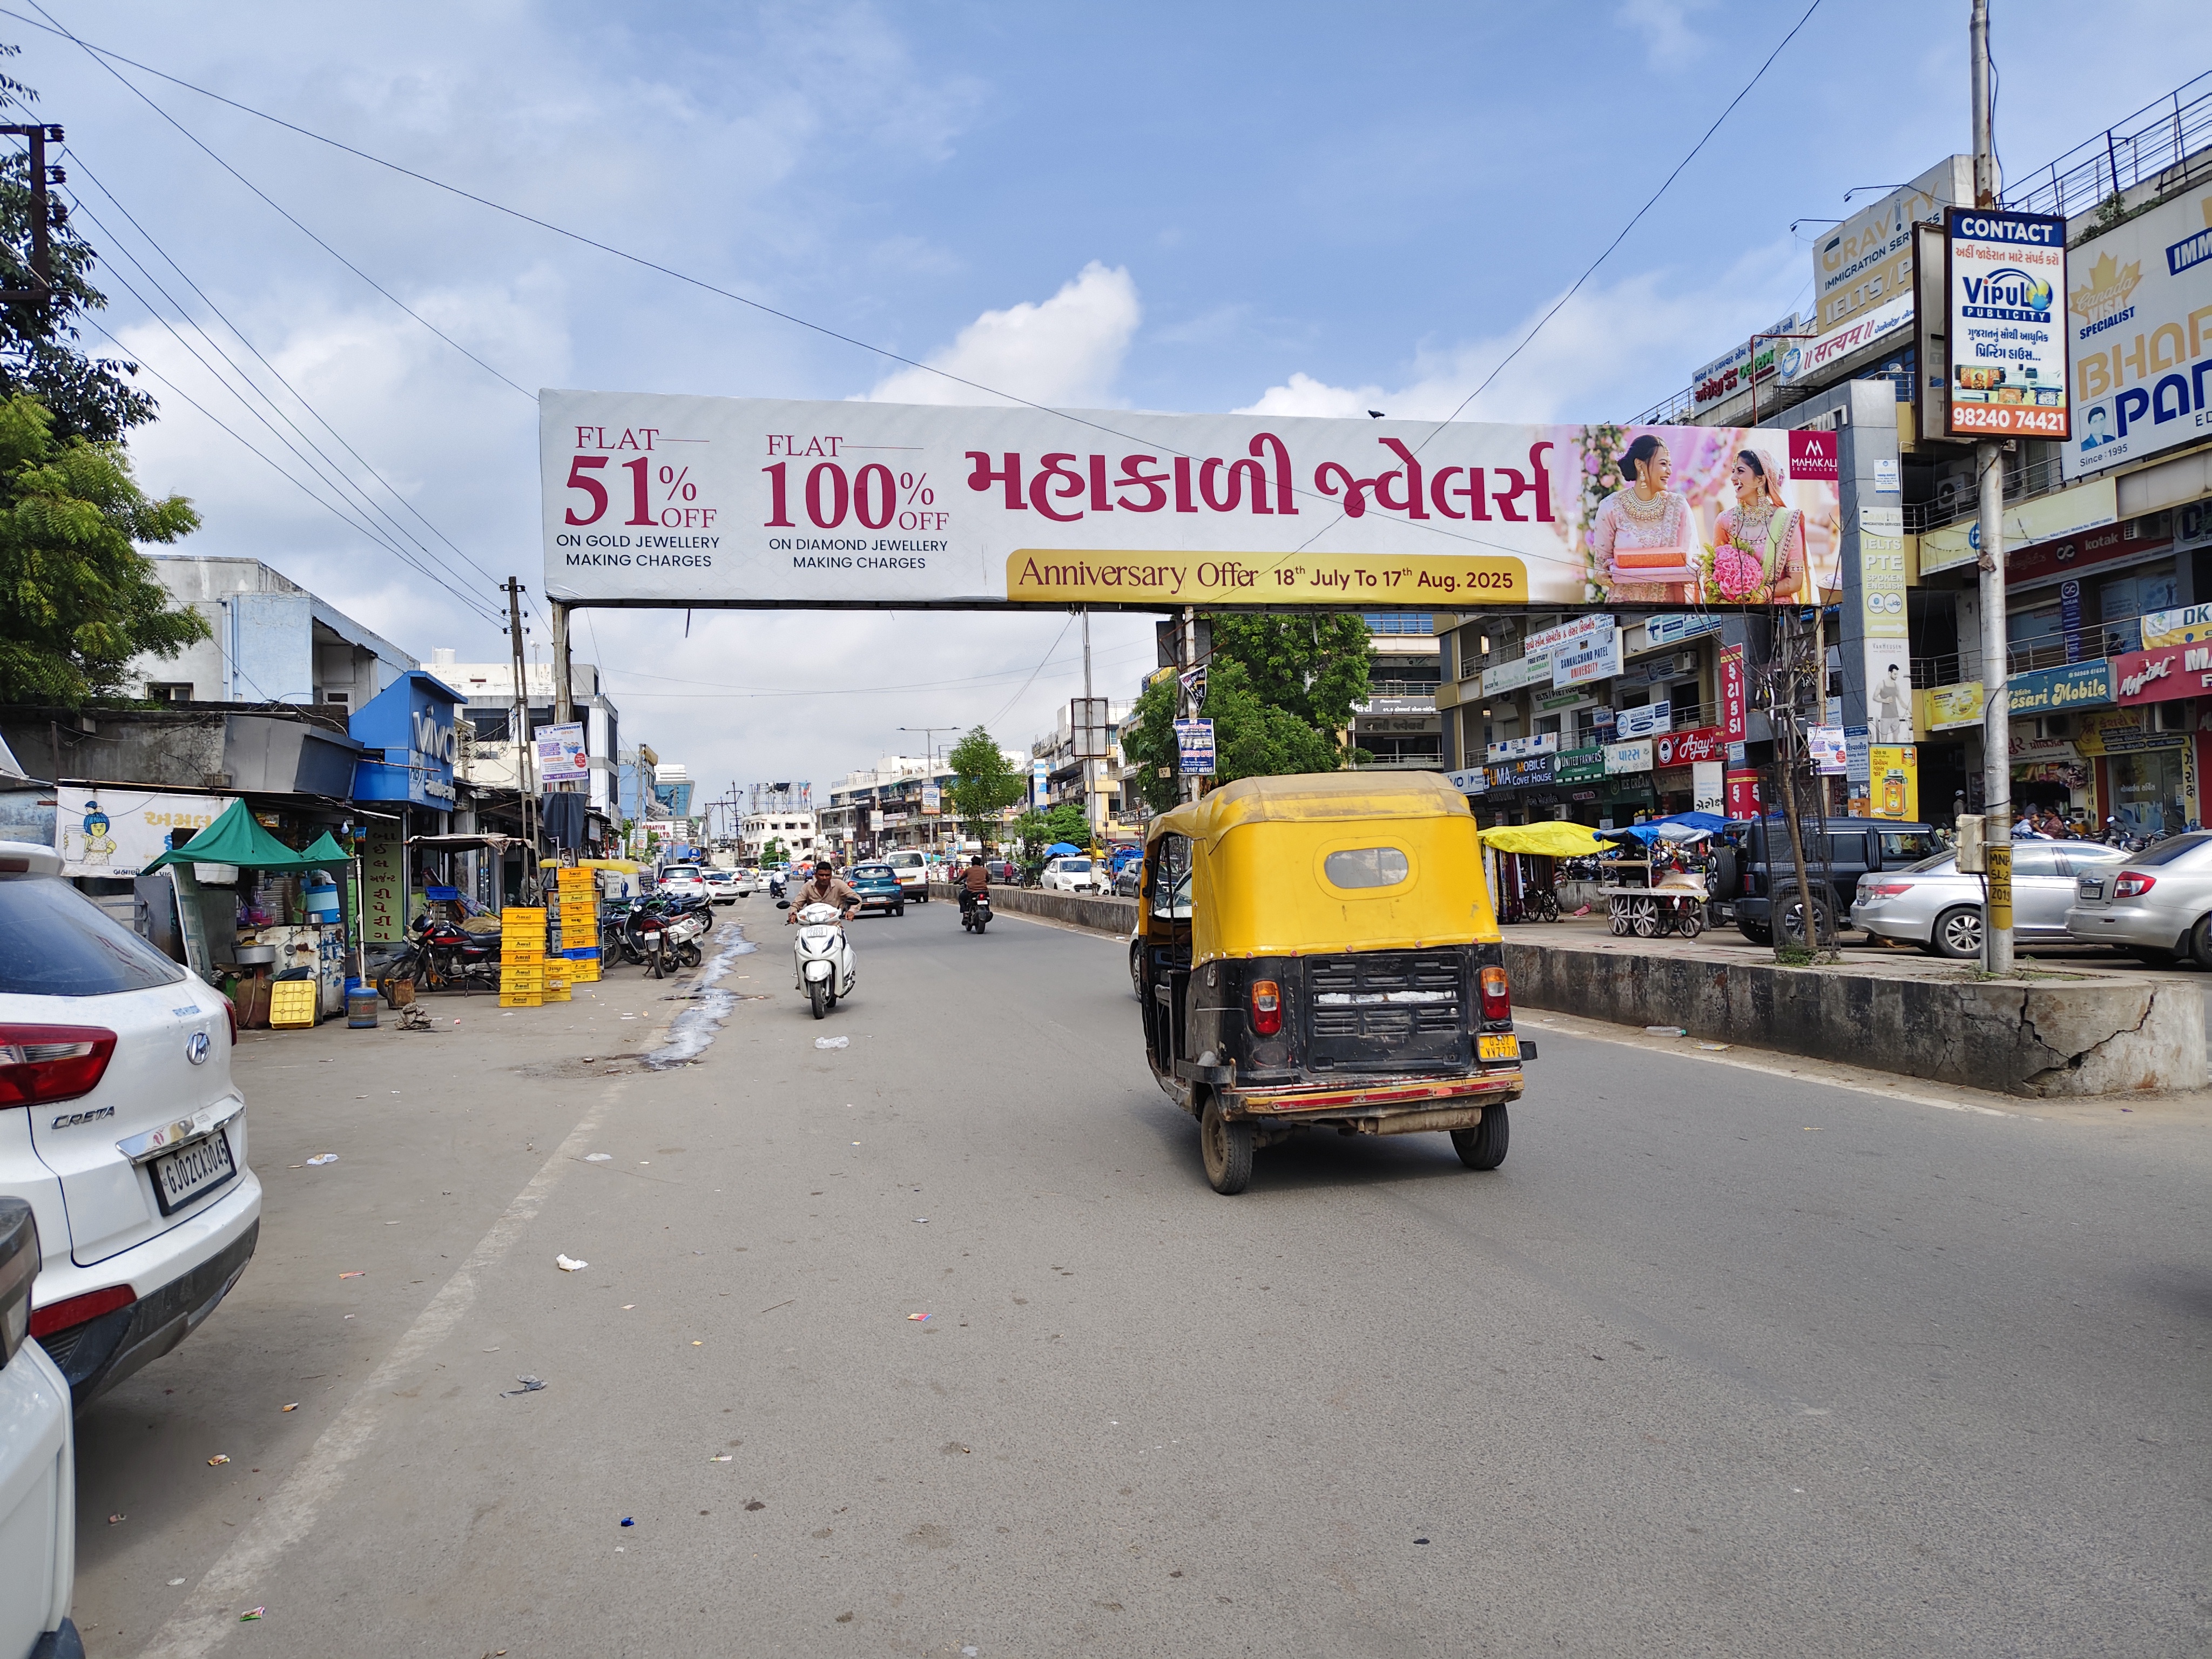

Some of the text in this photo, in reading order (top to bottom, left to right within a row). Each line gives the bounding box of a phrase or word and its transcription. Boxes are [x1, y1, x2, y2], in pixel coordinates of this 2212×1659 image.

[1961, 217, 2052, 242] CONTACT
[1976, 247, 2005, 260] જાહેરાત
[2009, 249, 2023, 262] માટે
[2025, 251, 2044, 264] સંપર્ક
[1825, 246, 1886, 291] IMMIGRATION
[2076, 271, 2134, 312] Canada
[1967, 308, 2045, 321] PUBLICITY
[2087, 296, 2127, 324] VISA
[2080, 306, 2135, 340] SPECIALIST
[1968, 327, 2048, 345] ગુજરાતનું સૌથી આધુનિક
[1953, 407, 2063, 430] 98240 74421
[575, 426, 659, 450] FLAT
[766, 435, 843, 457] FLAT
[1792, 458, 1837, 467] MAHAKALI
[2080, 452, 2103, 467] Since
[965, 433, 1555, 522] મહાકાળી જ્વેલર્સ
[660, 508, 717, 528] OFF
[899, 512, 949, 531] OFF
[557, 534, 719, 549] ON GOLD JEWELLERY
[769, 538, 948, 552] ON DIAMOND JEWELLERY
[1864, 538, 1901, 550] IELTS
[2086, 533, 2119, 551] kotak
[566, 554, 712, 567] MAKING CHARGES
[793, 557, 926, 569] MAKING CHARGES
[1865, 555, 1903, 570] PTE
[1020, 556, 1513, 594] Anniversary Offer 18th July To 17th Aug. 2025
[1528, 653, 1548, 665] FREE STUDY
[1561, 651, 1593, 669] SANKALCHAND
[1595, 646, 1608, 659] PATEL
[1570, 662, 1598, 679] UNIVERSITY
[2052, 678, 2106, 705] Mobile
[1561, 756, 1579, 767] UNITED
[1618, 748, 1640, 761] પારસ
[1516, 759, 1546, 773] MOBILE
[1990, 854, 2009, 866] MNP
[51, 1105, 114, 1129] CRETA
[165, 1139, 229, 1194] GJ02CA3045
